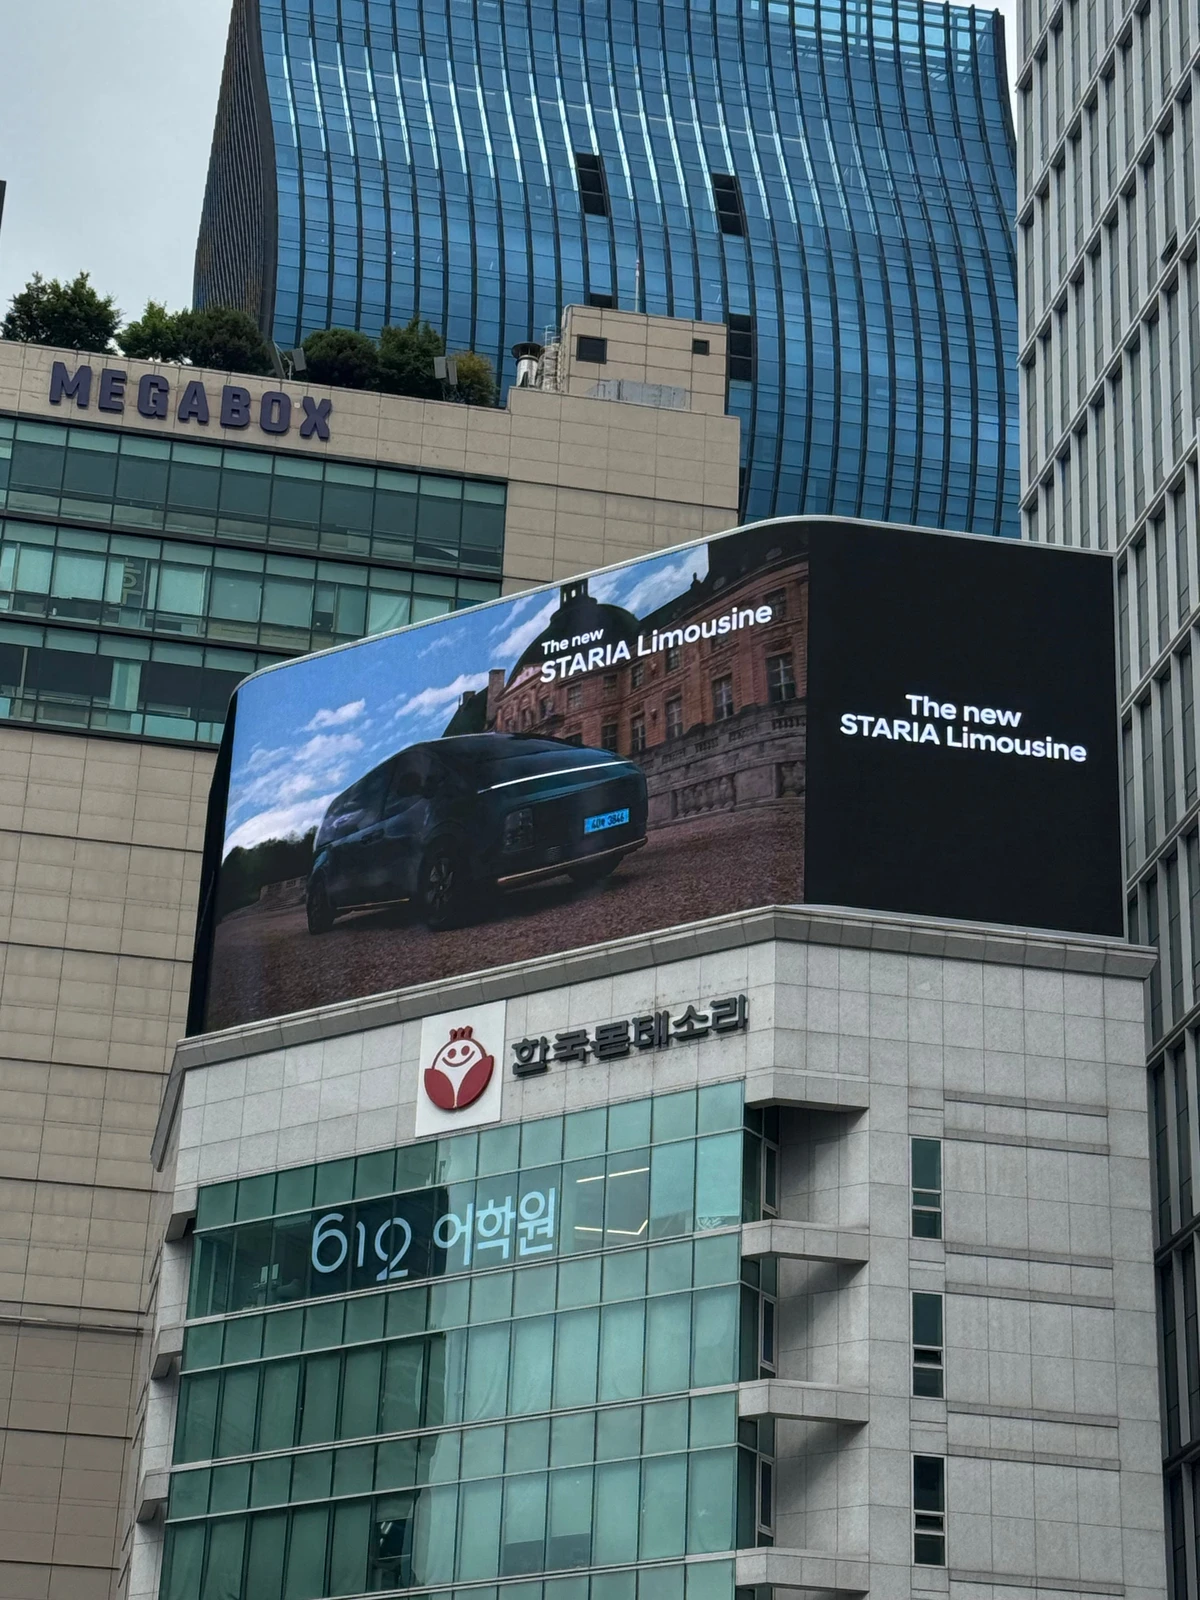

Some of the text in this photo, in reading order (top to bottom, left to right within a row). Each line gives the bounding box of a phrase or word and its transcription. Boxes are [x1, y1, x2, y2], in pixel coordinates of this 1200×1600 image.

[49, 361, 331, 440] MEGABOX
[541, 605, 773, 683] STARIA Limousine
[542, 629, 604, 656] The new
[840, 713, 1087, 763] STARIA Limousine
[905, 693, 1022, 728] The new
[512, 994, 748, 1076] 한국몬테소리
[311, 1187, 555, 1281] 612 어학원
